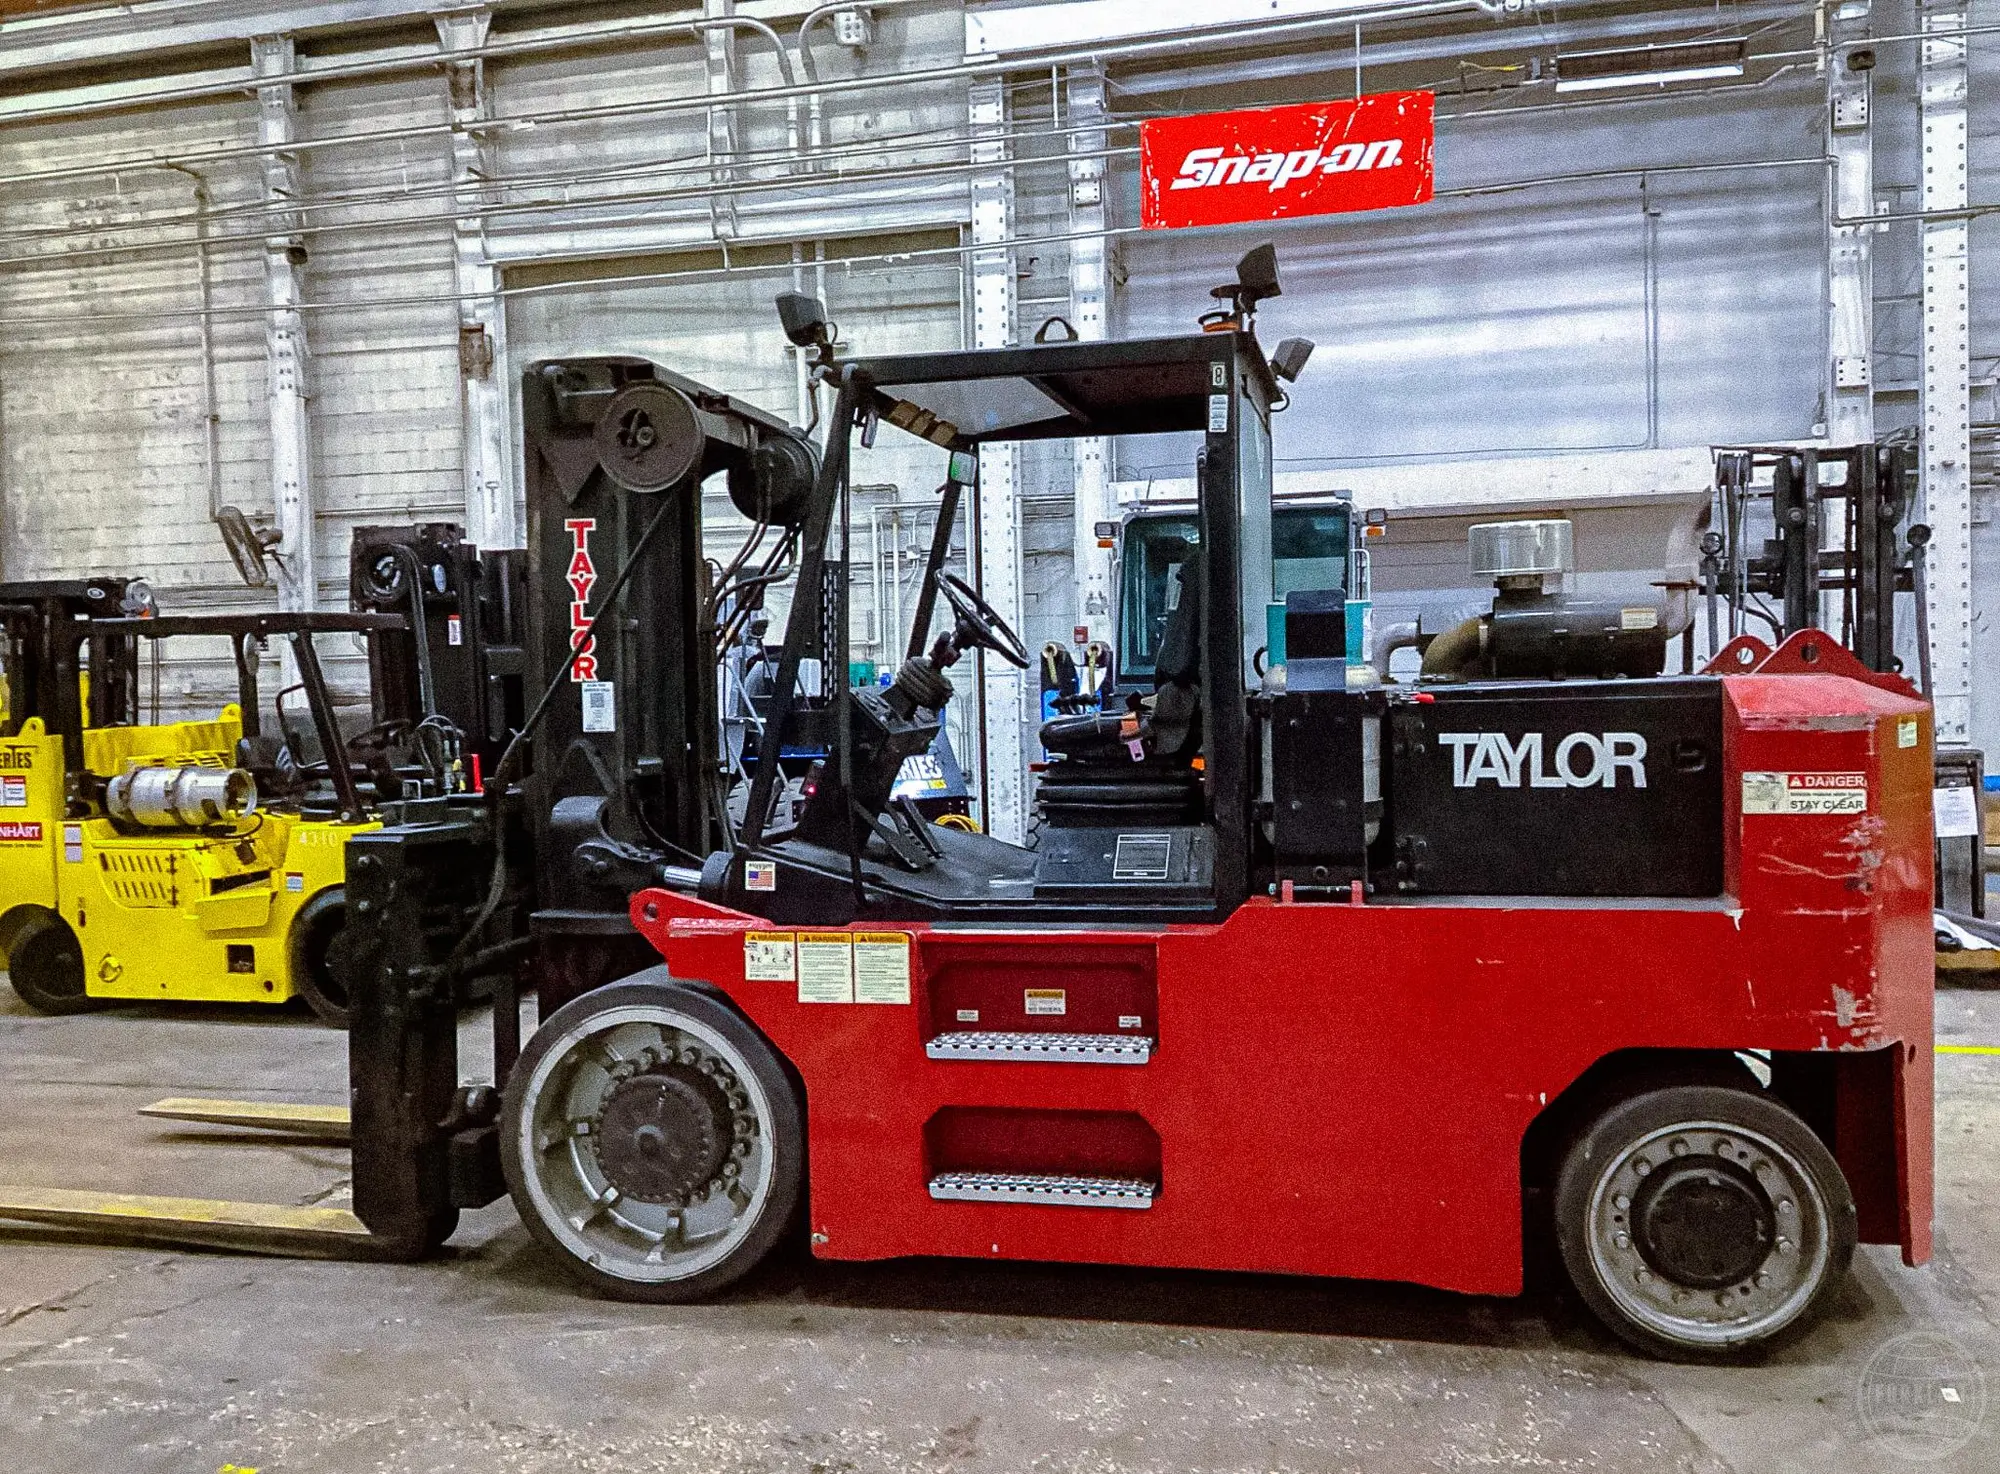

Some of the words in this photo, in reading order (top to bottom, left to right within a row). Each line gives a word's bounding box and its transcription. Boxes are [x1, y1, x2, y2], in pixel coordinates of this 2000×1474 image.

[565, 518, 598, 682] TAYLOR
[1438, 732, 1648, 788] TAYLOR
[1804, 775, 1865, 787] DANGER
[1790, 800, 1820, 809] STAY
[1823, 800, 1864, 810] CLEAR
